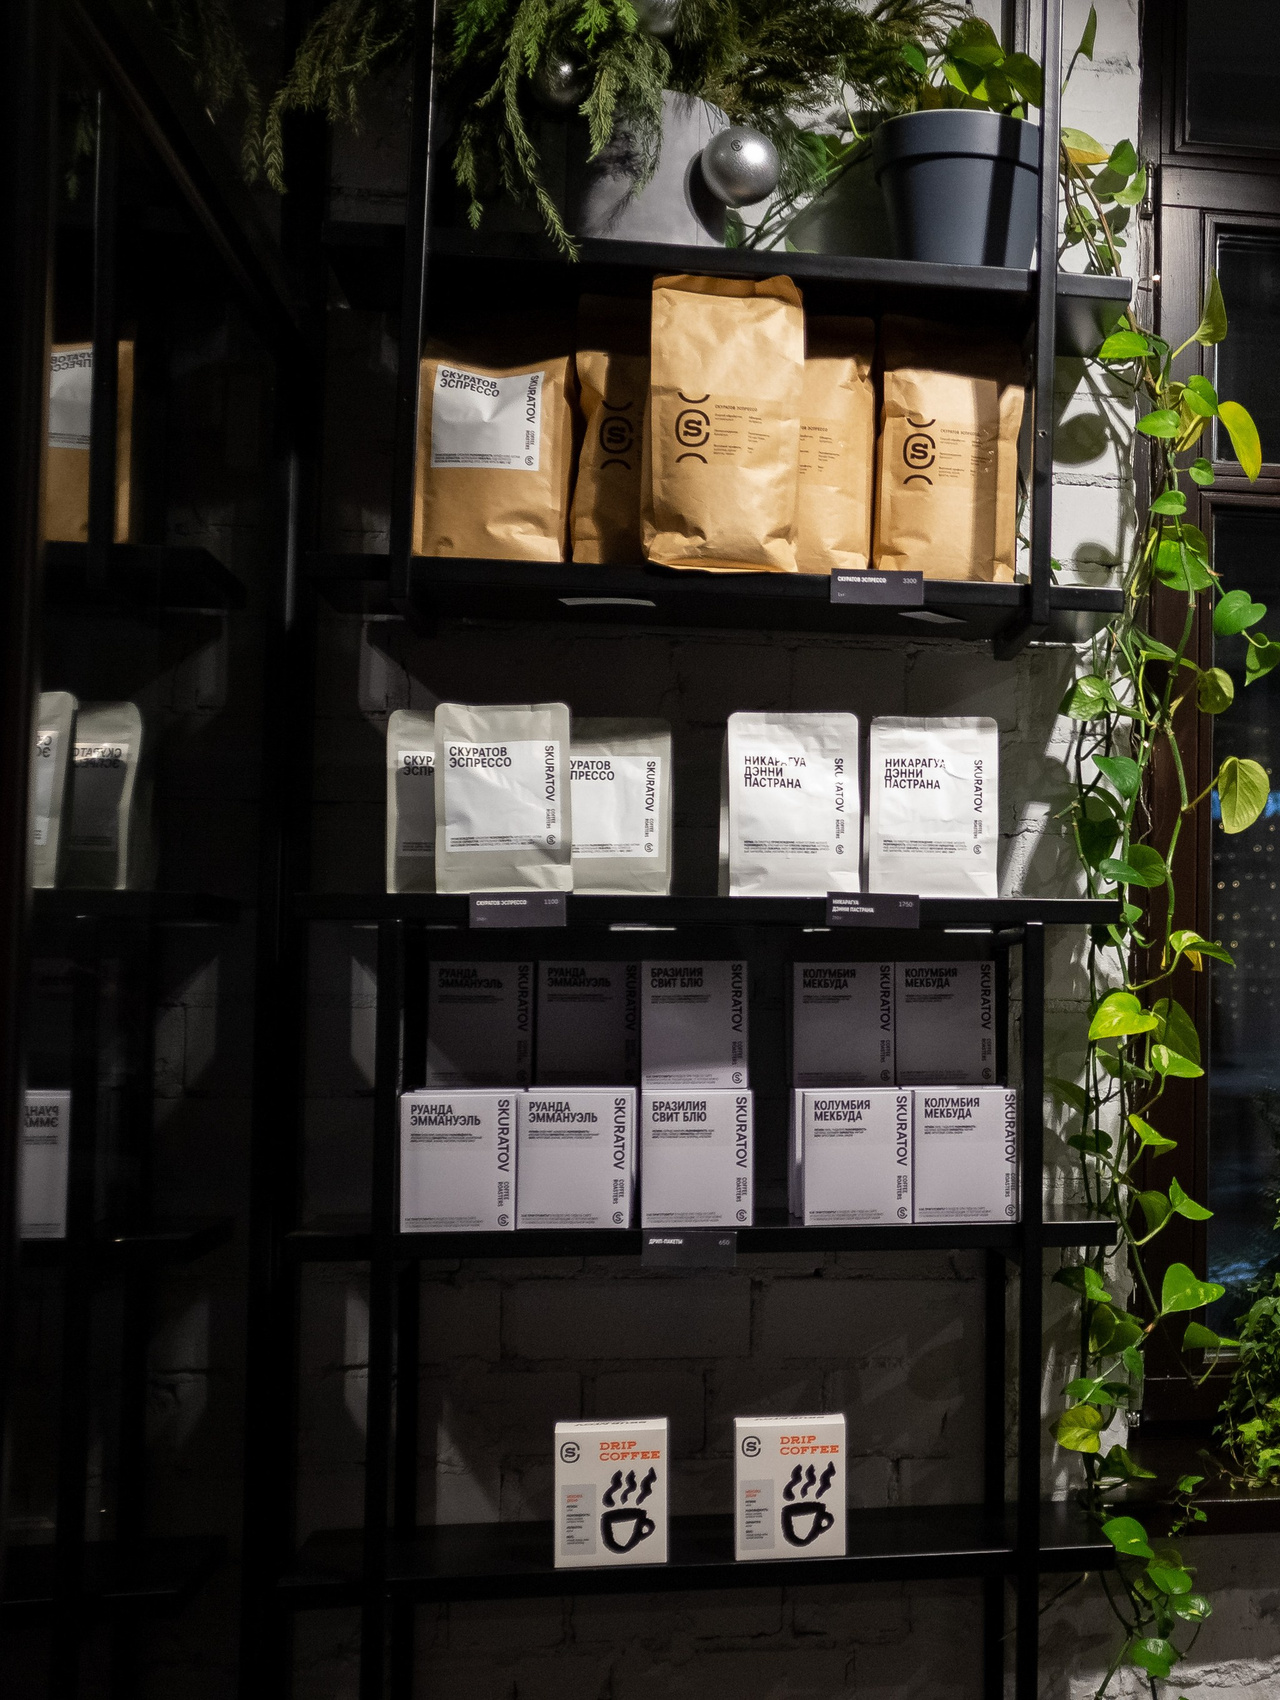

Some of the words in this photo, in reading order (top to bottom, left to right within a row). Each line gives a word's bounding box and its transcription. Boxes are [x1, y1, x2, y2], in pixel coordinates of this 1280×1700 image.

[441, 369, 497, 389] СКУРАТОВ
[440, 378, 500, 397] ЭСПРЕССО
[526, 375, 539, 423] SKURATOV
[449, 746, 508, 757] СКУРАТОВ
[403, 755, 434, 766] СКУР
[449, 757, 512, 768] ЭСПРЕССО
[569, 760, 611, 770] УРАТОВ
[744, 755, 807, 767] НИКАРГУА
[885, 758, 946, 769] НИКАРАГУА
[403, 766, 434, 776] ЭСПР
[544, 745, 555, 802] SKURATOV
[570, 770, 615, 781] ПРЕССО
[744, 766, 783, 778] ДЭННИ
[884, 768, 923, 780] ДЭННИ
[645, 761, 656, 812] SKURATOV
[744, 777, 802, 789] ПАСТРАНА
[884, 779, 941, 790] ПАСТРАНА
[973, 759, 983, 813] SKURATOV
[651, 967, 703, 978] БРАЗИЛИЯ
[803, 968, 856, 979] КОЛУМБИЯ
[905, 968, 958, 978] КОЛУМБИЯ
[650, 978, 677, 988] СВИТ
[680, 978, 703, 988] БЛЮ
[803, 979, 849, 990] МЕКБУДА
[905, 978, 950, 989] МЕКБУДА
[517, 965, 529, 1032] SKURATOV
[731, 964, 743, 1033] SKURATOV
[880, 965, 891, 1032] SKURATOV
[981, 964, 991, 1030] SKURATOV
[528, 1101, 571, 1113] РУАНДА
[652, 1101, 707, 1111] БРАЗИЛИЯ
[814, 1100, 870, 1110] КОЛУМБИЯ
[924, 1097, 980, 1108] КОЛУМБИЯ
[410, 1104, 453, 1116] РУАНДА
[924, 1108, 972, 1120] МЕКБУДА
[410, 1115, 481, 1126] ЭММАНУЭЛЬ
[528, 1112, 598, 1123] ЭММАНУЭЛЬ
[652, 1111, 680, 1122] СВИТ
[683, 1111, 707, 1122] БЛЮ
[814, 1110, 862, 1122] МЕКБУДА
[613, 1097, 626, 1170] SKURATOV
[736, 1096, 747, 1168] SKURATOV
[896, 1095, 907, 1166] SKURATOV
[1004, 1093, 1016, 1164] SKURATOV
[497, 1099, 510, 1172] SKURATOV
[780, 1435, 816, 1445] DRIP
[599, 1441, 637, 1451] DRIP
[780, 1445, 839, 1456] COFFEE
[599, 1450, 661, 1461] COFFEE
